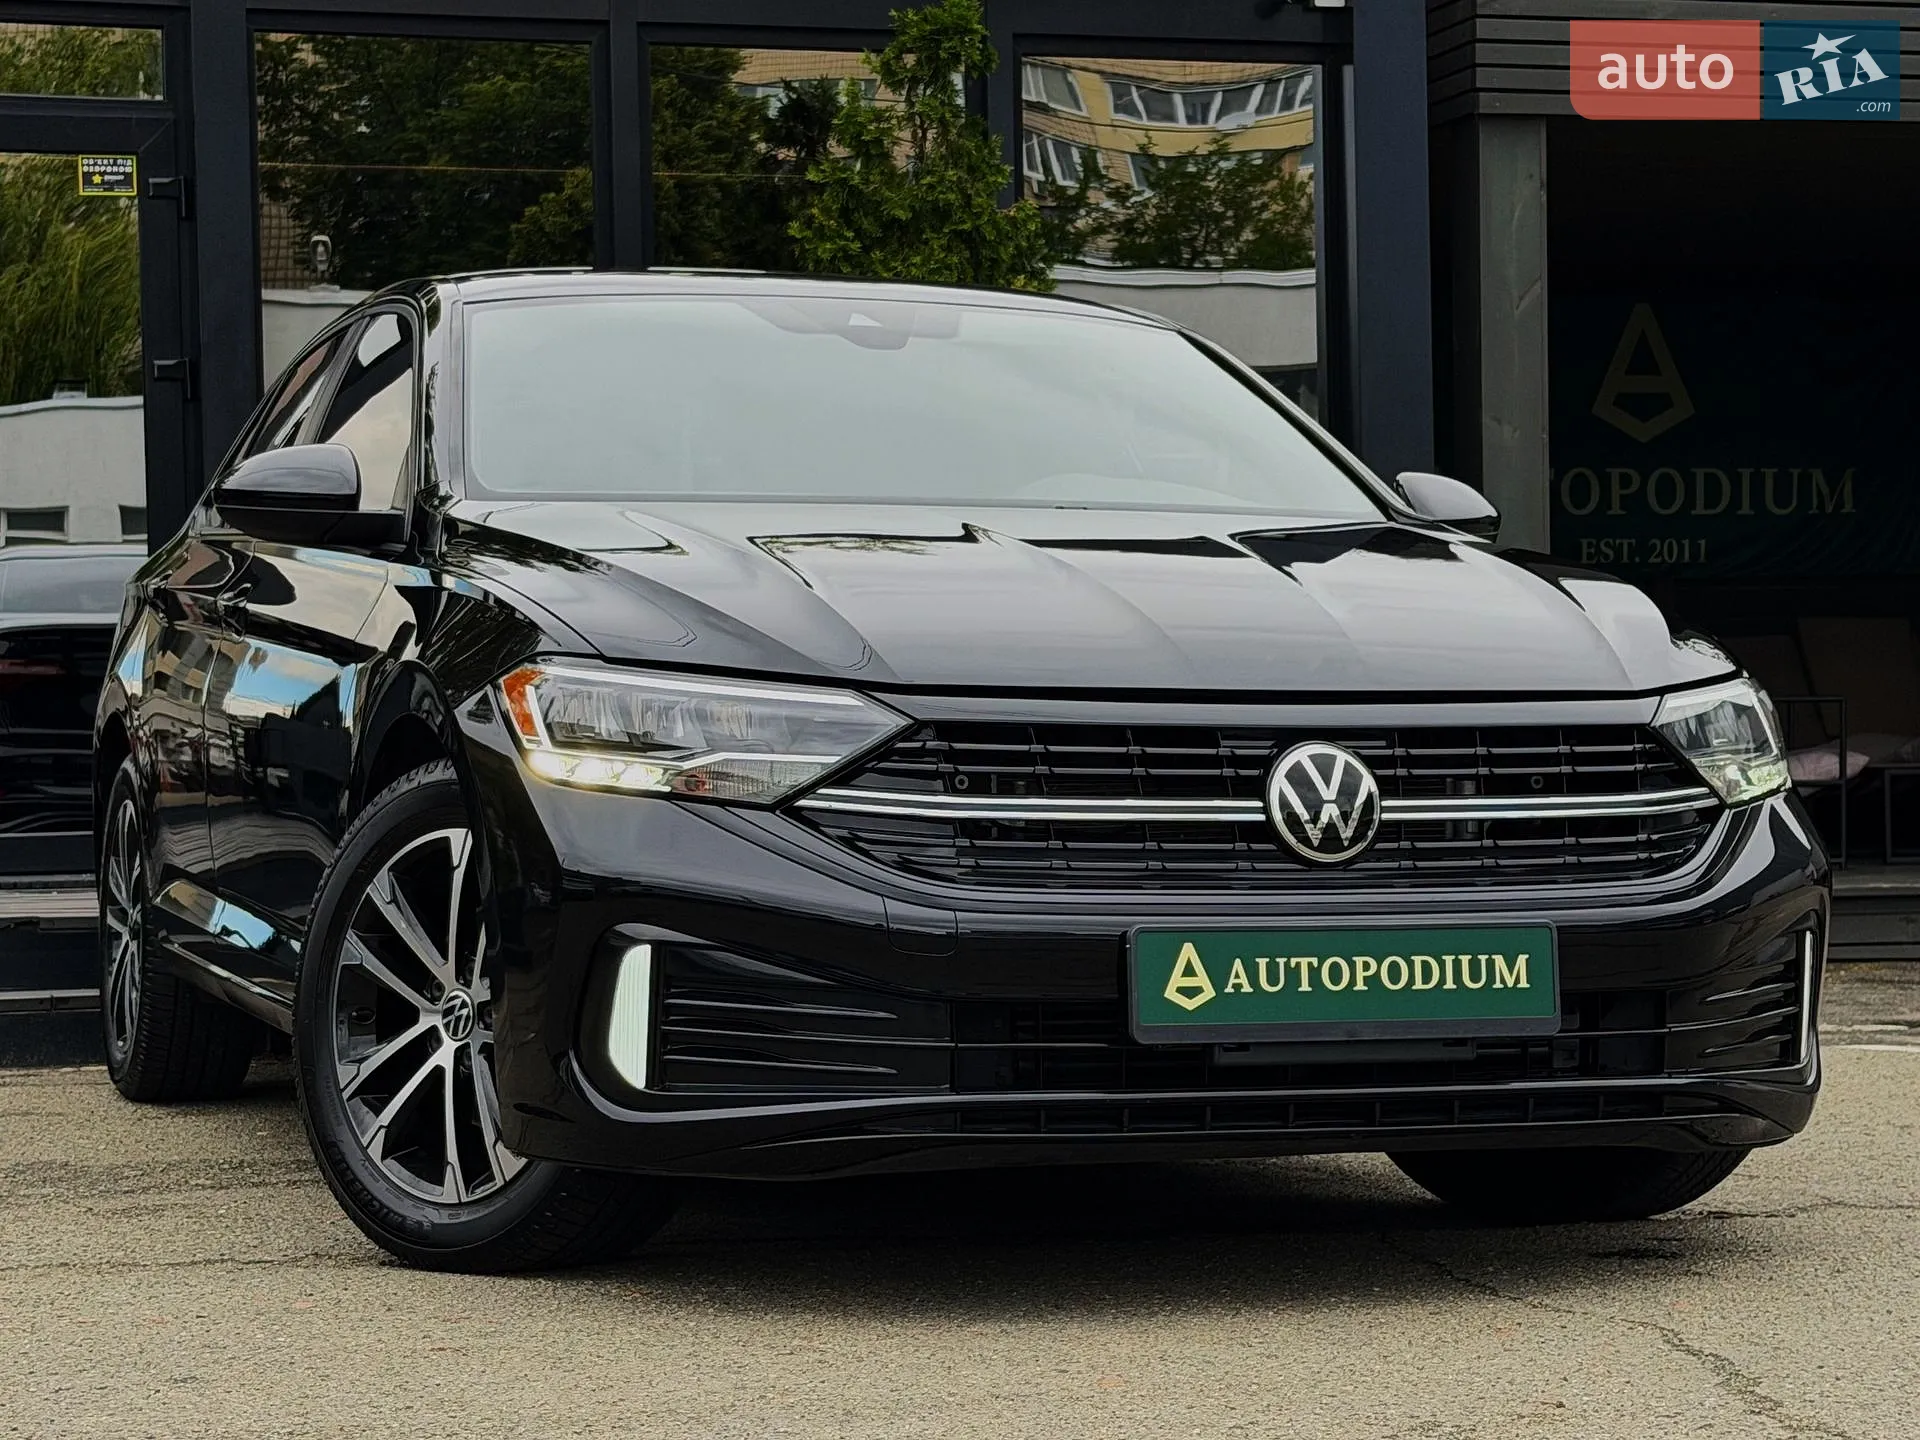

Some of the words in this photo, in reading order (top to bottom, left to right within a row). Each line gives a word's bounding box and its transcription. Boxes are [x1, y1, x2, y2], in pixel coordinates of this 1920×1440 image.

[1550, 466, 1858, 517] OPODIUM
[1580, 537, 1641, 565] EST.
[1647, 537, 1710, 565] 2011
[1224, 953, 1530, 994] AUTOPODIUM
